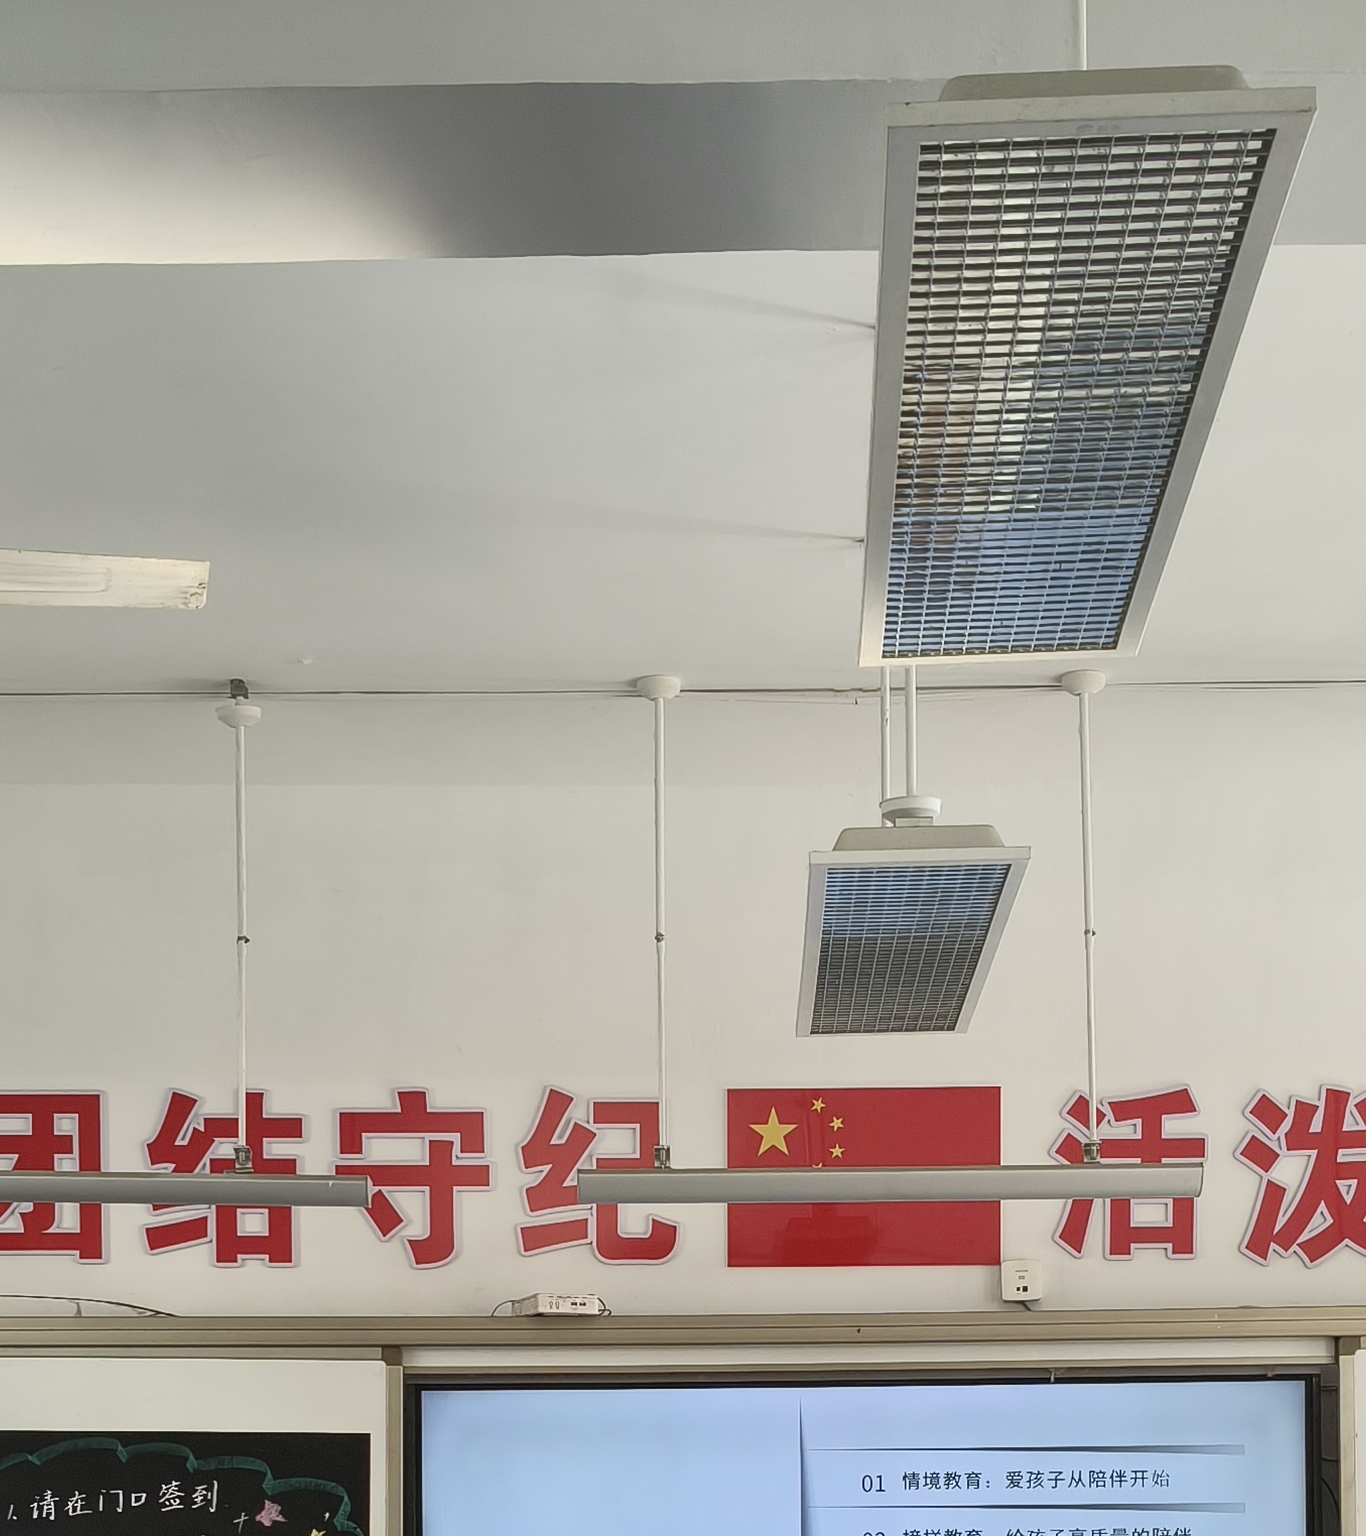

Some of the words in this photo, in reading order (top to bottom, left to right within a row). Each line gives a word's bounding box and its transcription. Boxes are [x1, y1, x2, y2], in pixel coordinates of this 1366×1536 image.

[862, 1474, 886, 1492] 01
[902, 1468, 1170, 1491] 情境教育：爱孩子从陪伴开始
